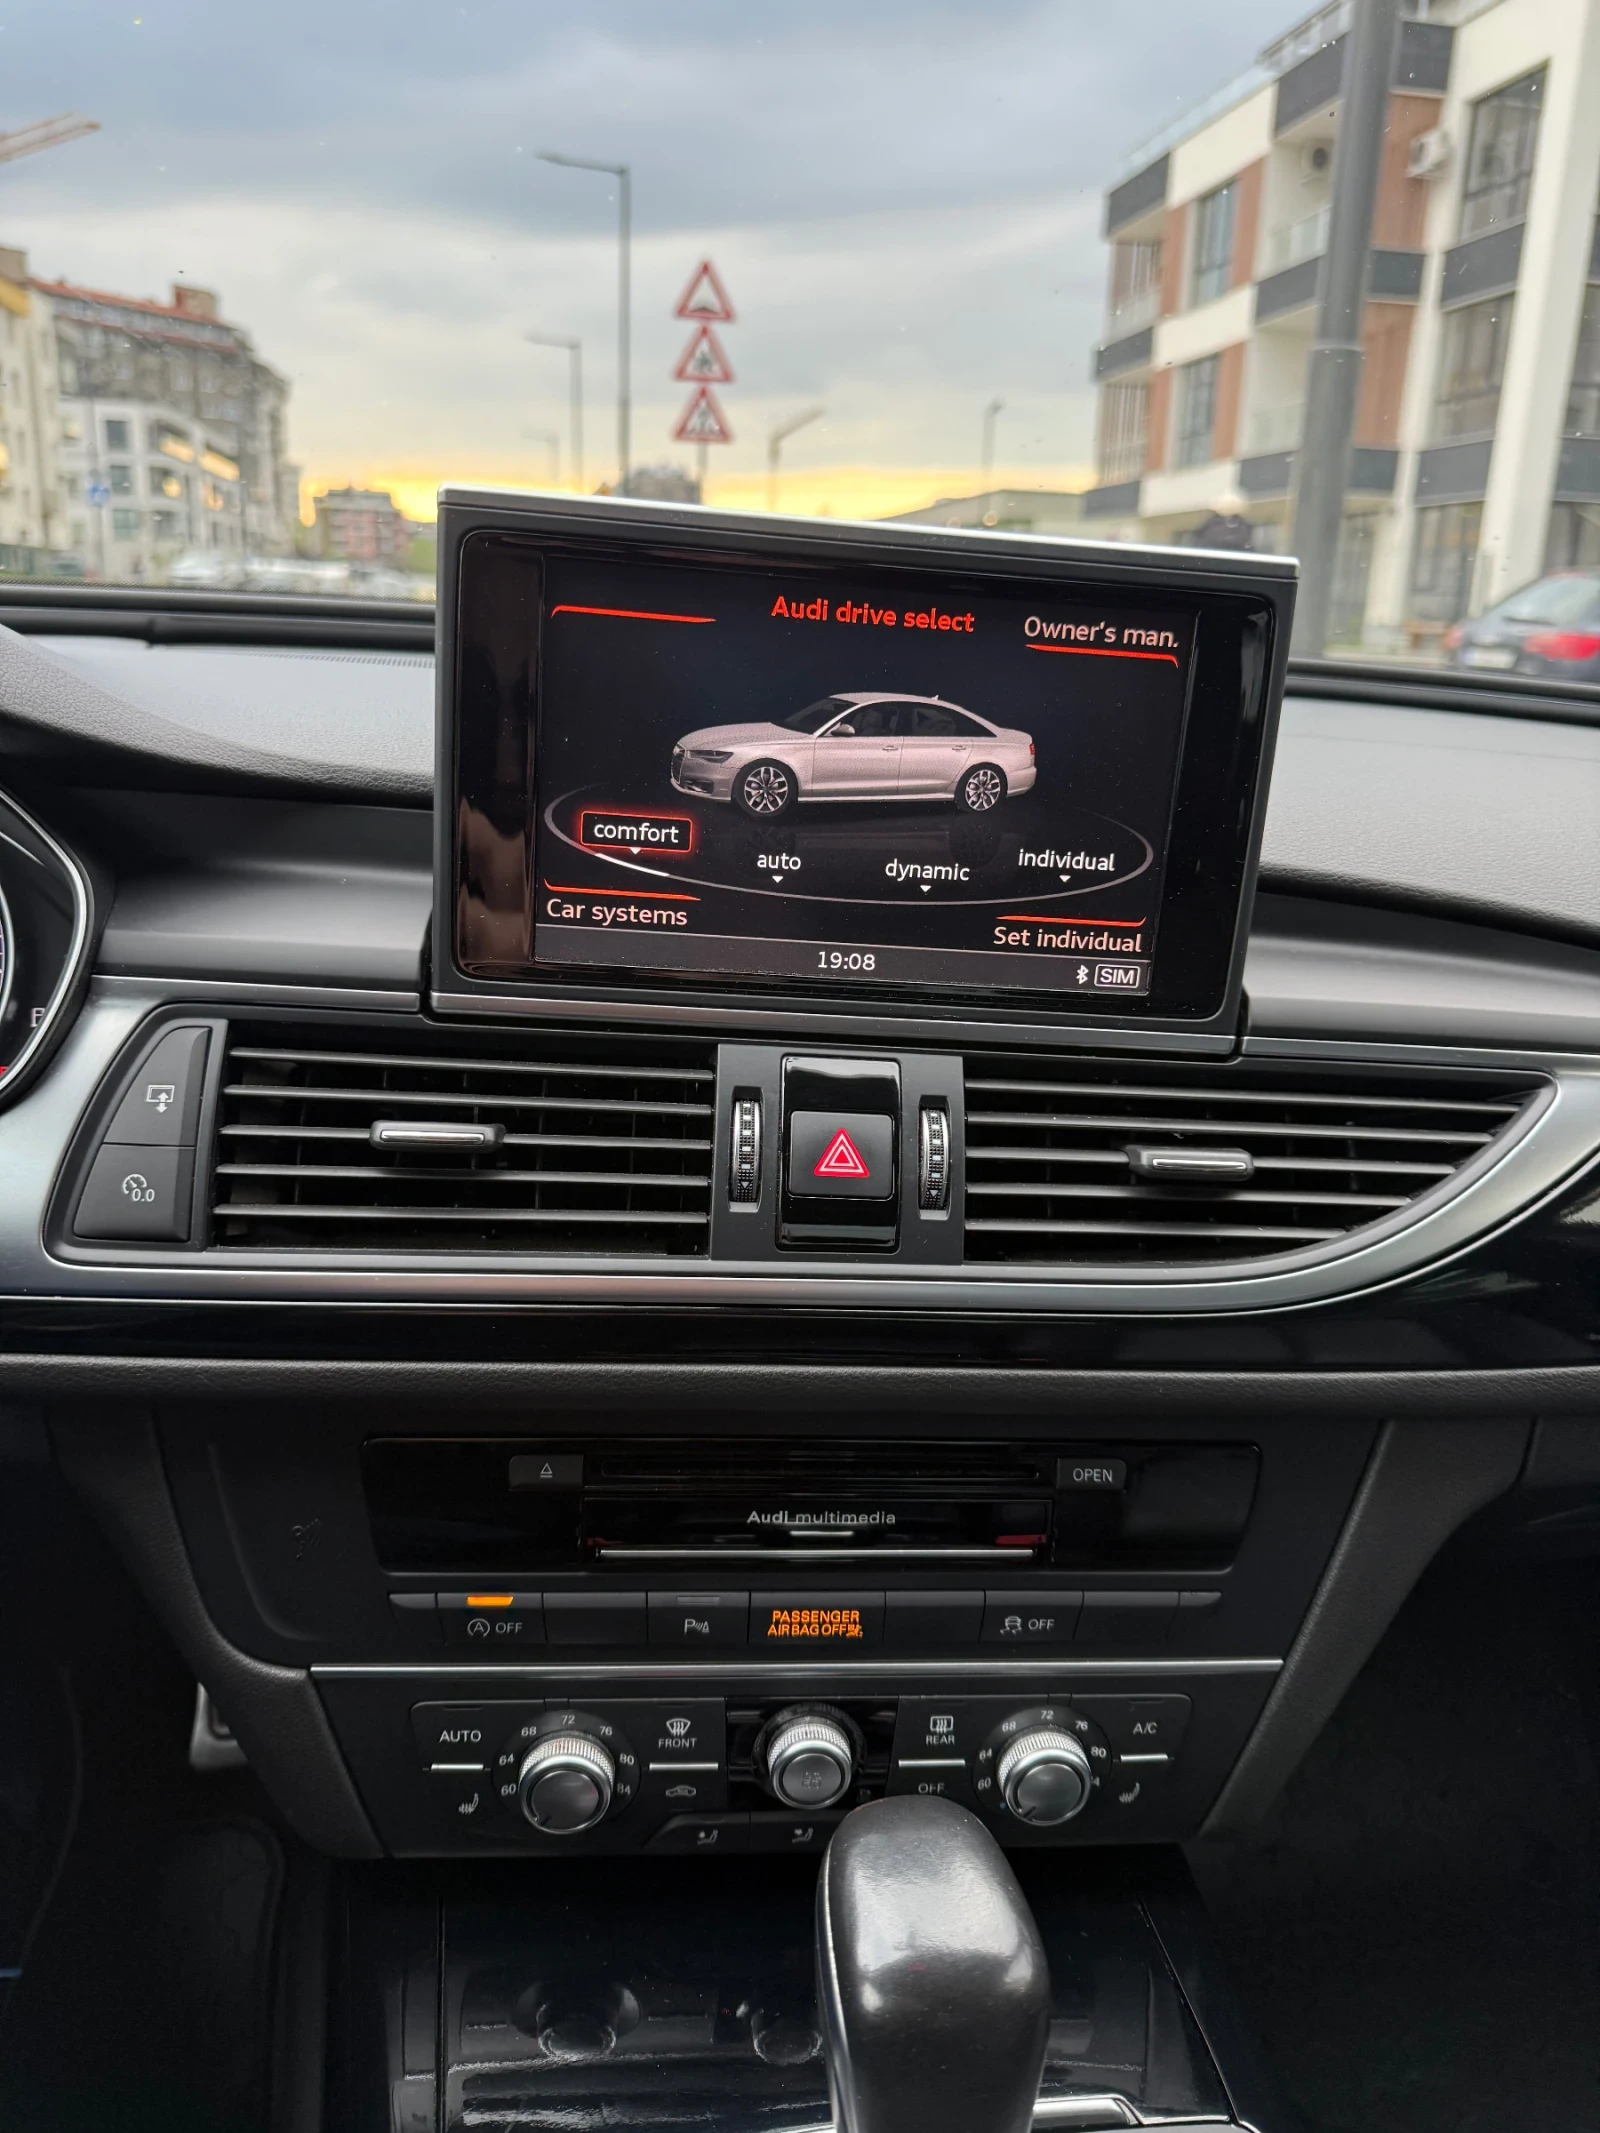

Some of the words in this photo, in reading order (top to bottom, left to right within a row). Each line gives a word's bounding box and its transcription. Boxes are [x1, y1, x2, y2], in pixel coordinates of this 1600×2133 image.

[772, 596, 827, 622] Audi
[835, 600, 897, 627] drive
[903, 606, 975, 633] select
[1024, 616, 1116, 644] Owner's
[1123, 628, 1179, 648] man.
[593, 820, 680, 844] comfort
[756, 852, 802, 871] auto
[1018, 848, 1115, 873] individual
[884, 857, 970, 884] dynamic
[546, 898, 585, 918] Car
[591, 905, 688, 926] systems
[993, 926, 1030, 946] Set
[1036, 930, 1142, 954] individual
[817, 951, 875, 970] 19:08
[1100, 967, 1134, 985] SIM
[1072, 1468, 1113, 1483] OPEN
[747, 1511, 788, 1524] Audi
[795, 1511, 896, 1525] multimedia
[772, 1610, 860, 1624] PASSENGER
[495, 1622, 523, 1635] OFF
[767, 1624, 820, 1637] AIRBAG
[821, 1624, 847, 1637] OFF
[1028, 1619, 1055, 1631] OFF
[560, 1714, 576, 1726] 72
[1040, 1709, 1055, 1721] 72
[521, 1725, 537, 1737] 68
[599, 1725, 613, 1737] 76
[1001, 1721, 1017, 1733] 68
[1074, 1720, 1089, 1732] 76
[1133, 1722, 1158, 1736] A/C
[439, 1730, 482, 1743] AUTO
[658, 1737, 698, 1749] FRONT
[925, 1734, 956, 1746] REAR
[979, 1748, 994, 1761] 64
[1090, 1746, 1107, 1758] 80
[499, 1753, 515, 1766] 64
[619, 1753, 635, 1766] 80
[501, 1784, 517, 1796] 60
[616, 1783, 632, 1796] 84
[918, 1782, 945, 1795] OFF
[977, 1777, 992, 1790] 60
